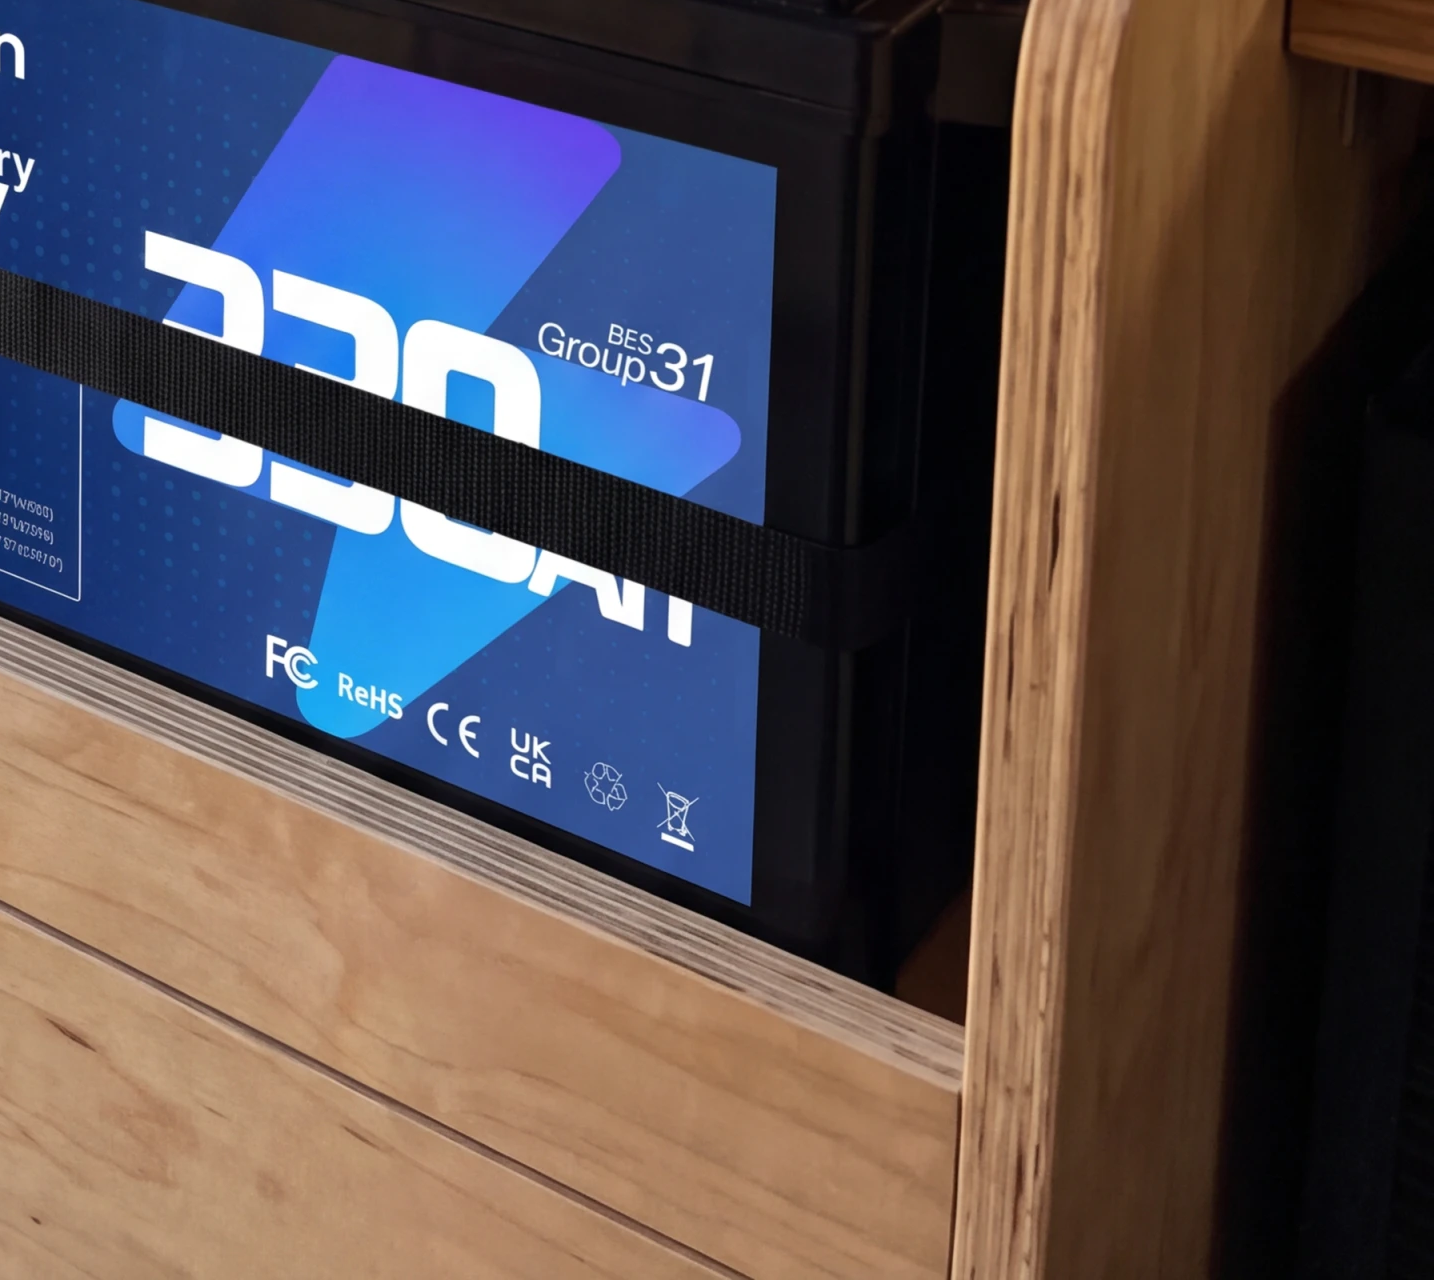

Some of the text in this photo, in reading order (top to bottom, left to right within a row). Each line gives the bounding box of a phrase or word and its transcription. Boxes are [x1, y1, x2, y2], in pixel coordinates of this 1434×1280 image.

[607, 323, 654, 355] BES
[427, 702, 481, 758] CE
[511, 727, 551, 765] UK
[510, 754, 551, 789] CA
